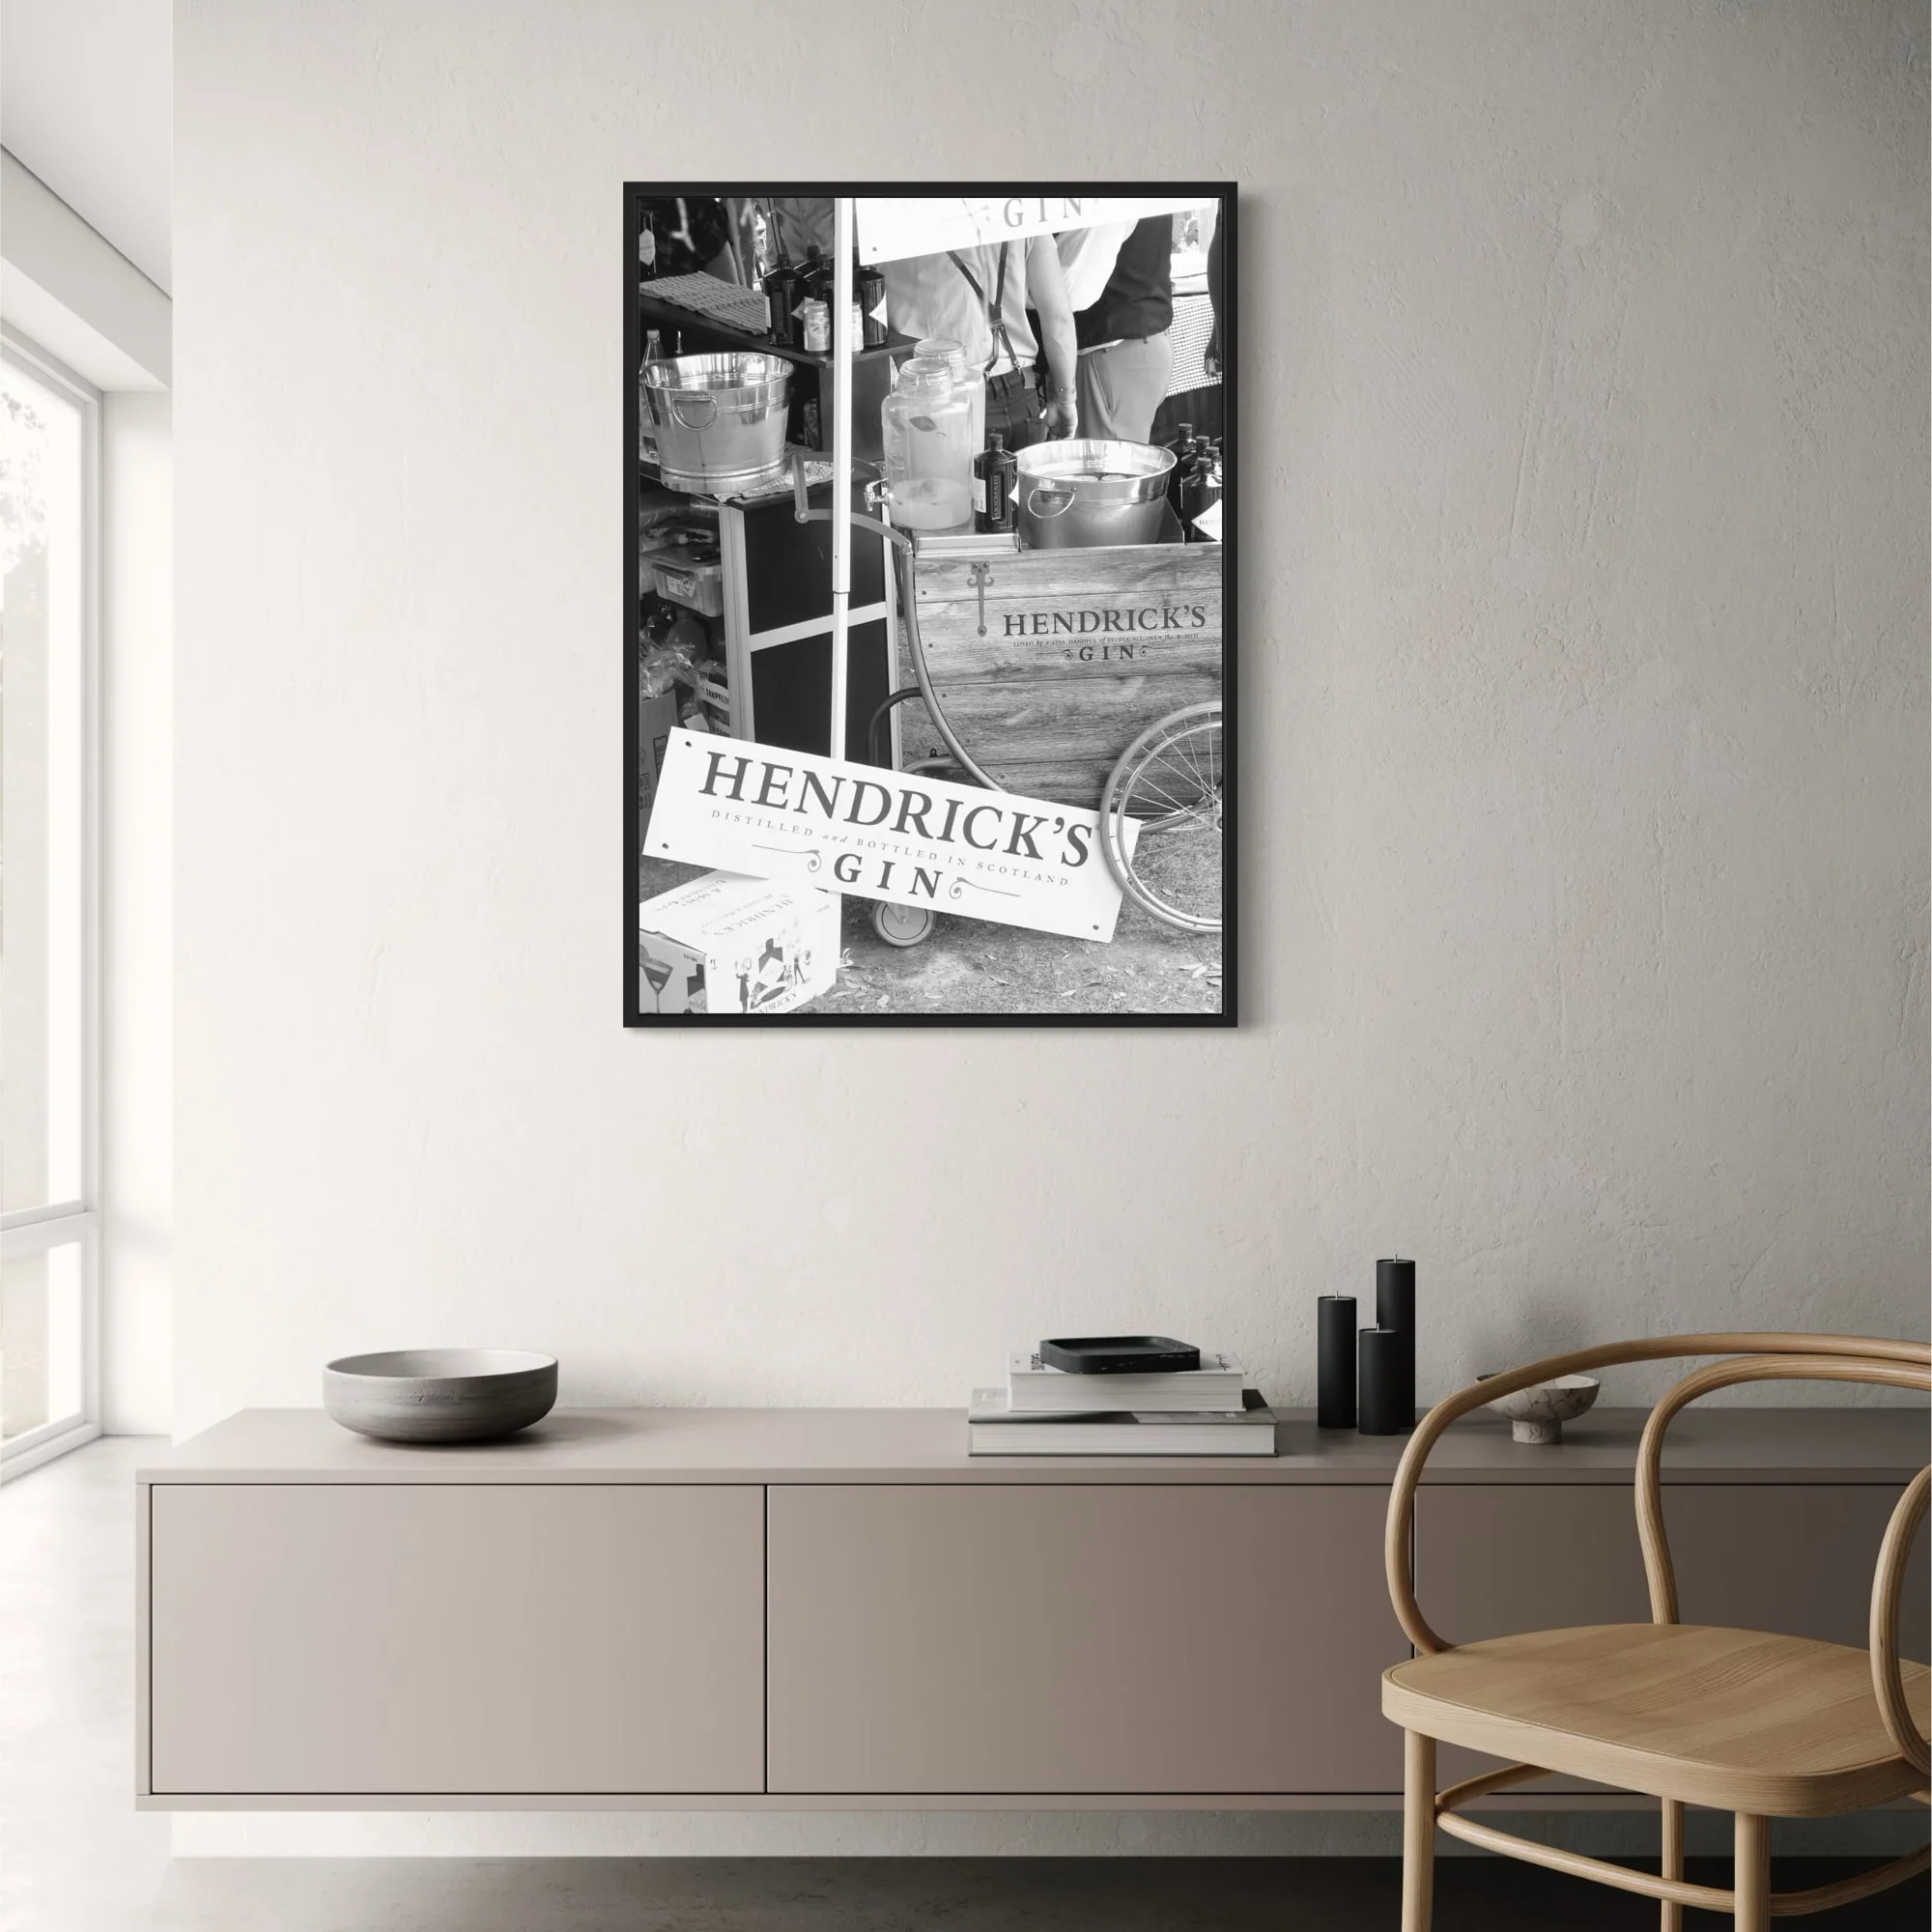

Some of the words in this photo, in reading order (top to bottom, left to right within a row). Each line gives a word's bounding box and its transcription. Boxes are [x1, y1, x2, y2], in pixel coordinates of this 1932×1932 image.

[1003, 198, 1082, 228] GIN
[1003, 605, 1206, 637] HENDRICK'S
[1079, 644, 1134, 662] GIN
[698, 751, 1093, 867] HENDRICK'S
[711, 810, 813, 837] DISTILLED
[822, 834, 848, 843] and
[857, 838, 937, 861] BOTTLED
[948, 855, 967, 867] IN
[976, 862, 1069, 887] SCOTLAND
[834, 853, 944, 899] GIN
